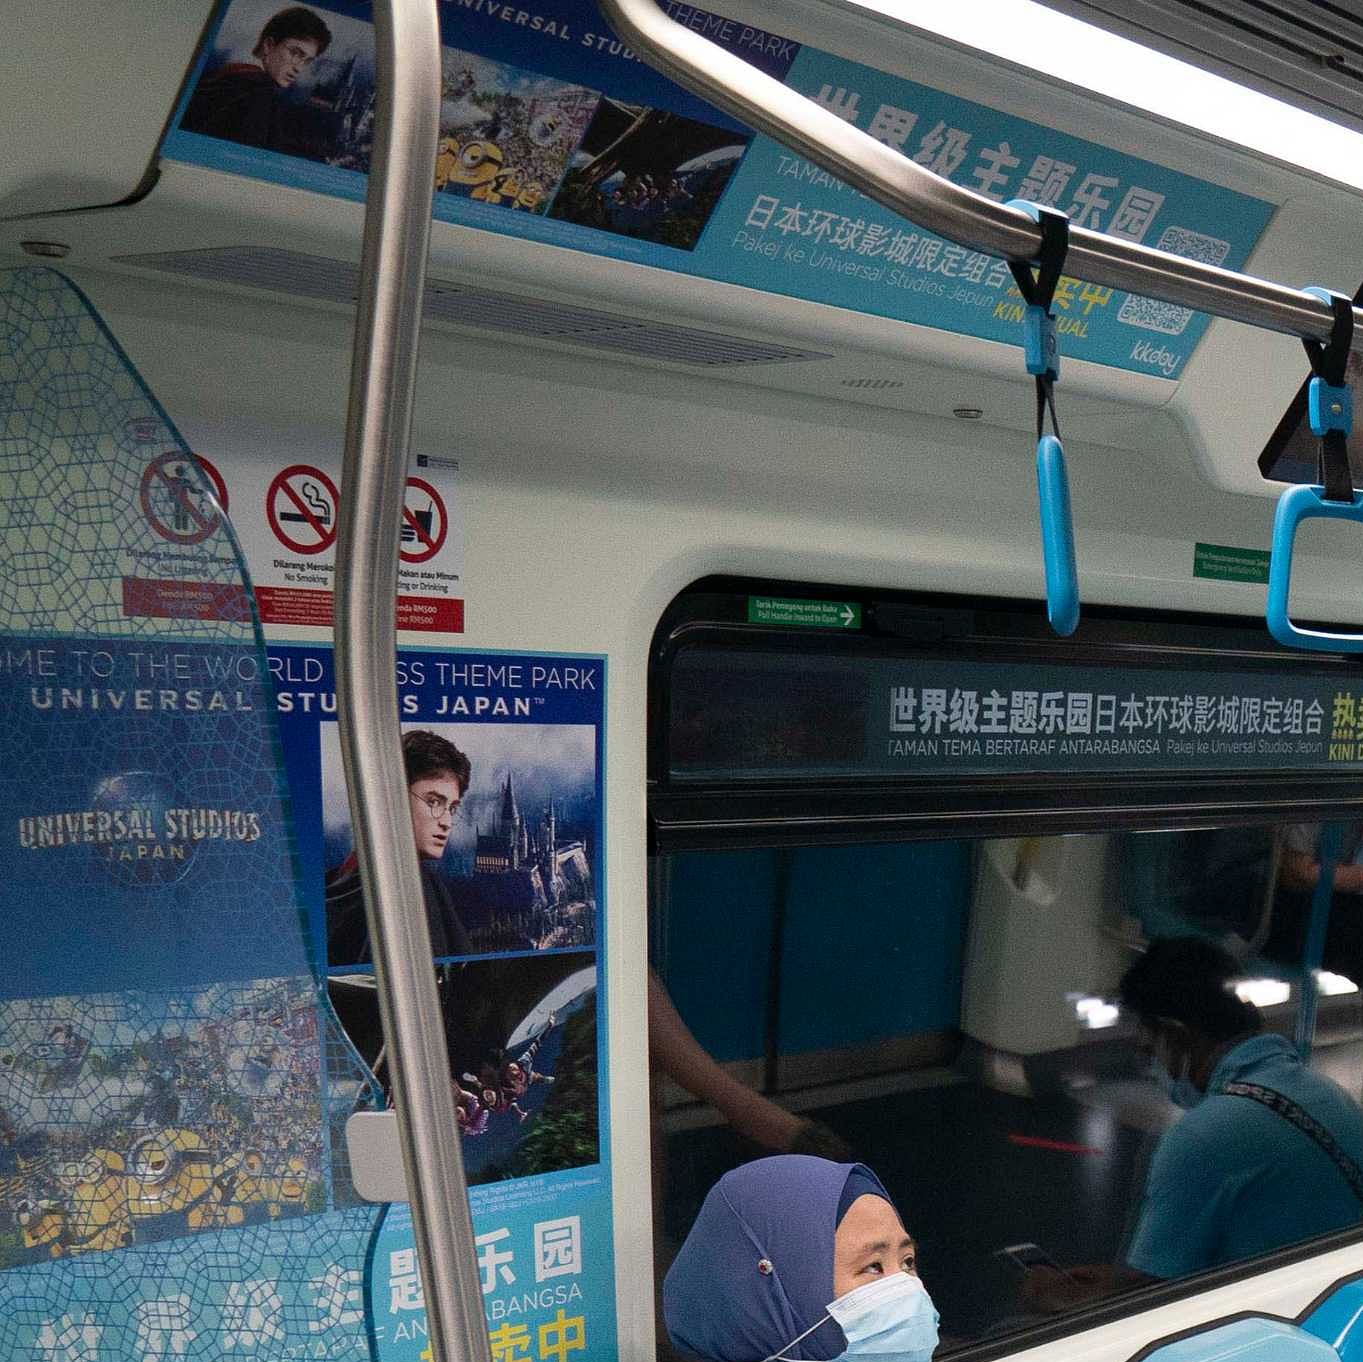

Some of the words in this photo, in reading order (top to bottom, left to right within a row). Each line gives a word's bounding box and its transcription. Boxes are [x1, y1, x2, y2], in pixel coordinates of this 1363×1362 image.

[738, 22, 795, 62] PARK
[809, 248, 885, 281] Universal
[886, 268, 945, 297] Studios
[1129, 340, 1181, 375] kkday
[273, 559, 306, 573] Dilarang
[306, 562, 335, 573] Meroko
[284, 573, 295, 581] No
[295, 574, 329, 586] Smoking
[419, 582, 449, 594] Drinking
[71, 651, 115, 678] TO
[128, 652, 192, 679] THE
[204, 653, 324, 683] WORLD
[435, 662, 523, 689] THEME
[531, 666, 597, 690] PARK
[31, 687, 252, 711] UNIVERSAL
[276, 690, 419, 714] STUS
[942, 738, 982, 756] TEMA
[985, 738, 1056, 756] BERTARAF
[1058, 738, 1161, 756] ANTARABANGSA
[1211, 740, 1256, 755] Universal
[1258, 740, 1294, 754] Studios
[1328, 743, 1354, 761] KINI
[19, 810, 157, 850] UNIVERSAL
[164, 807, 262, 843] STUDIOS
